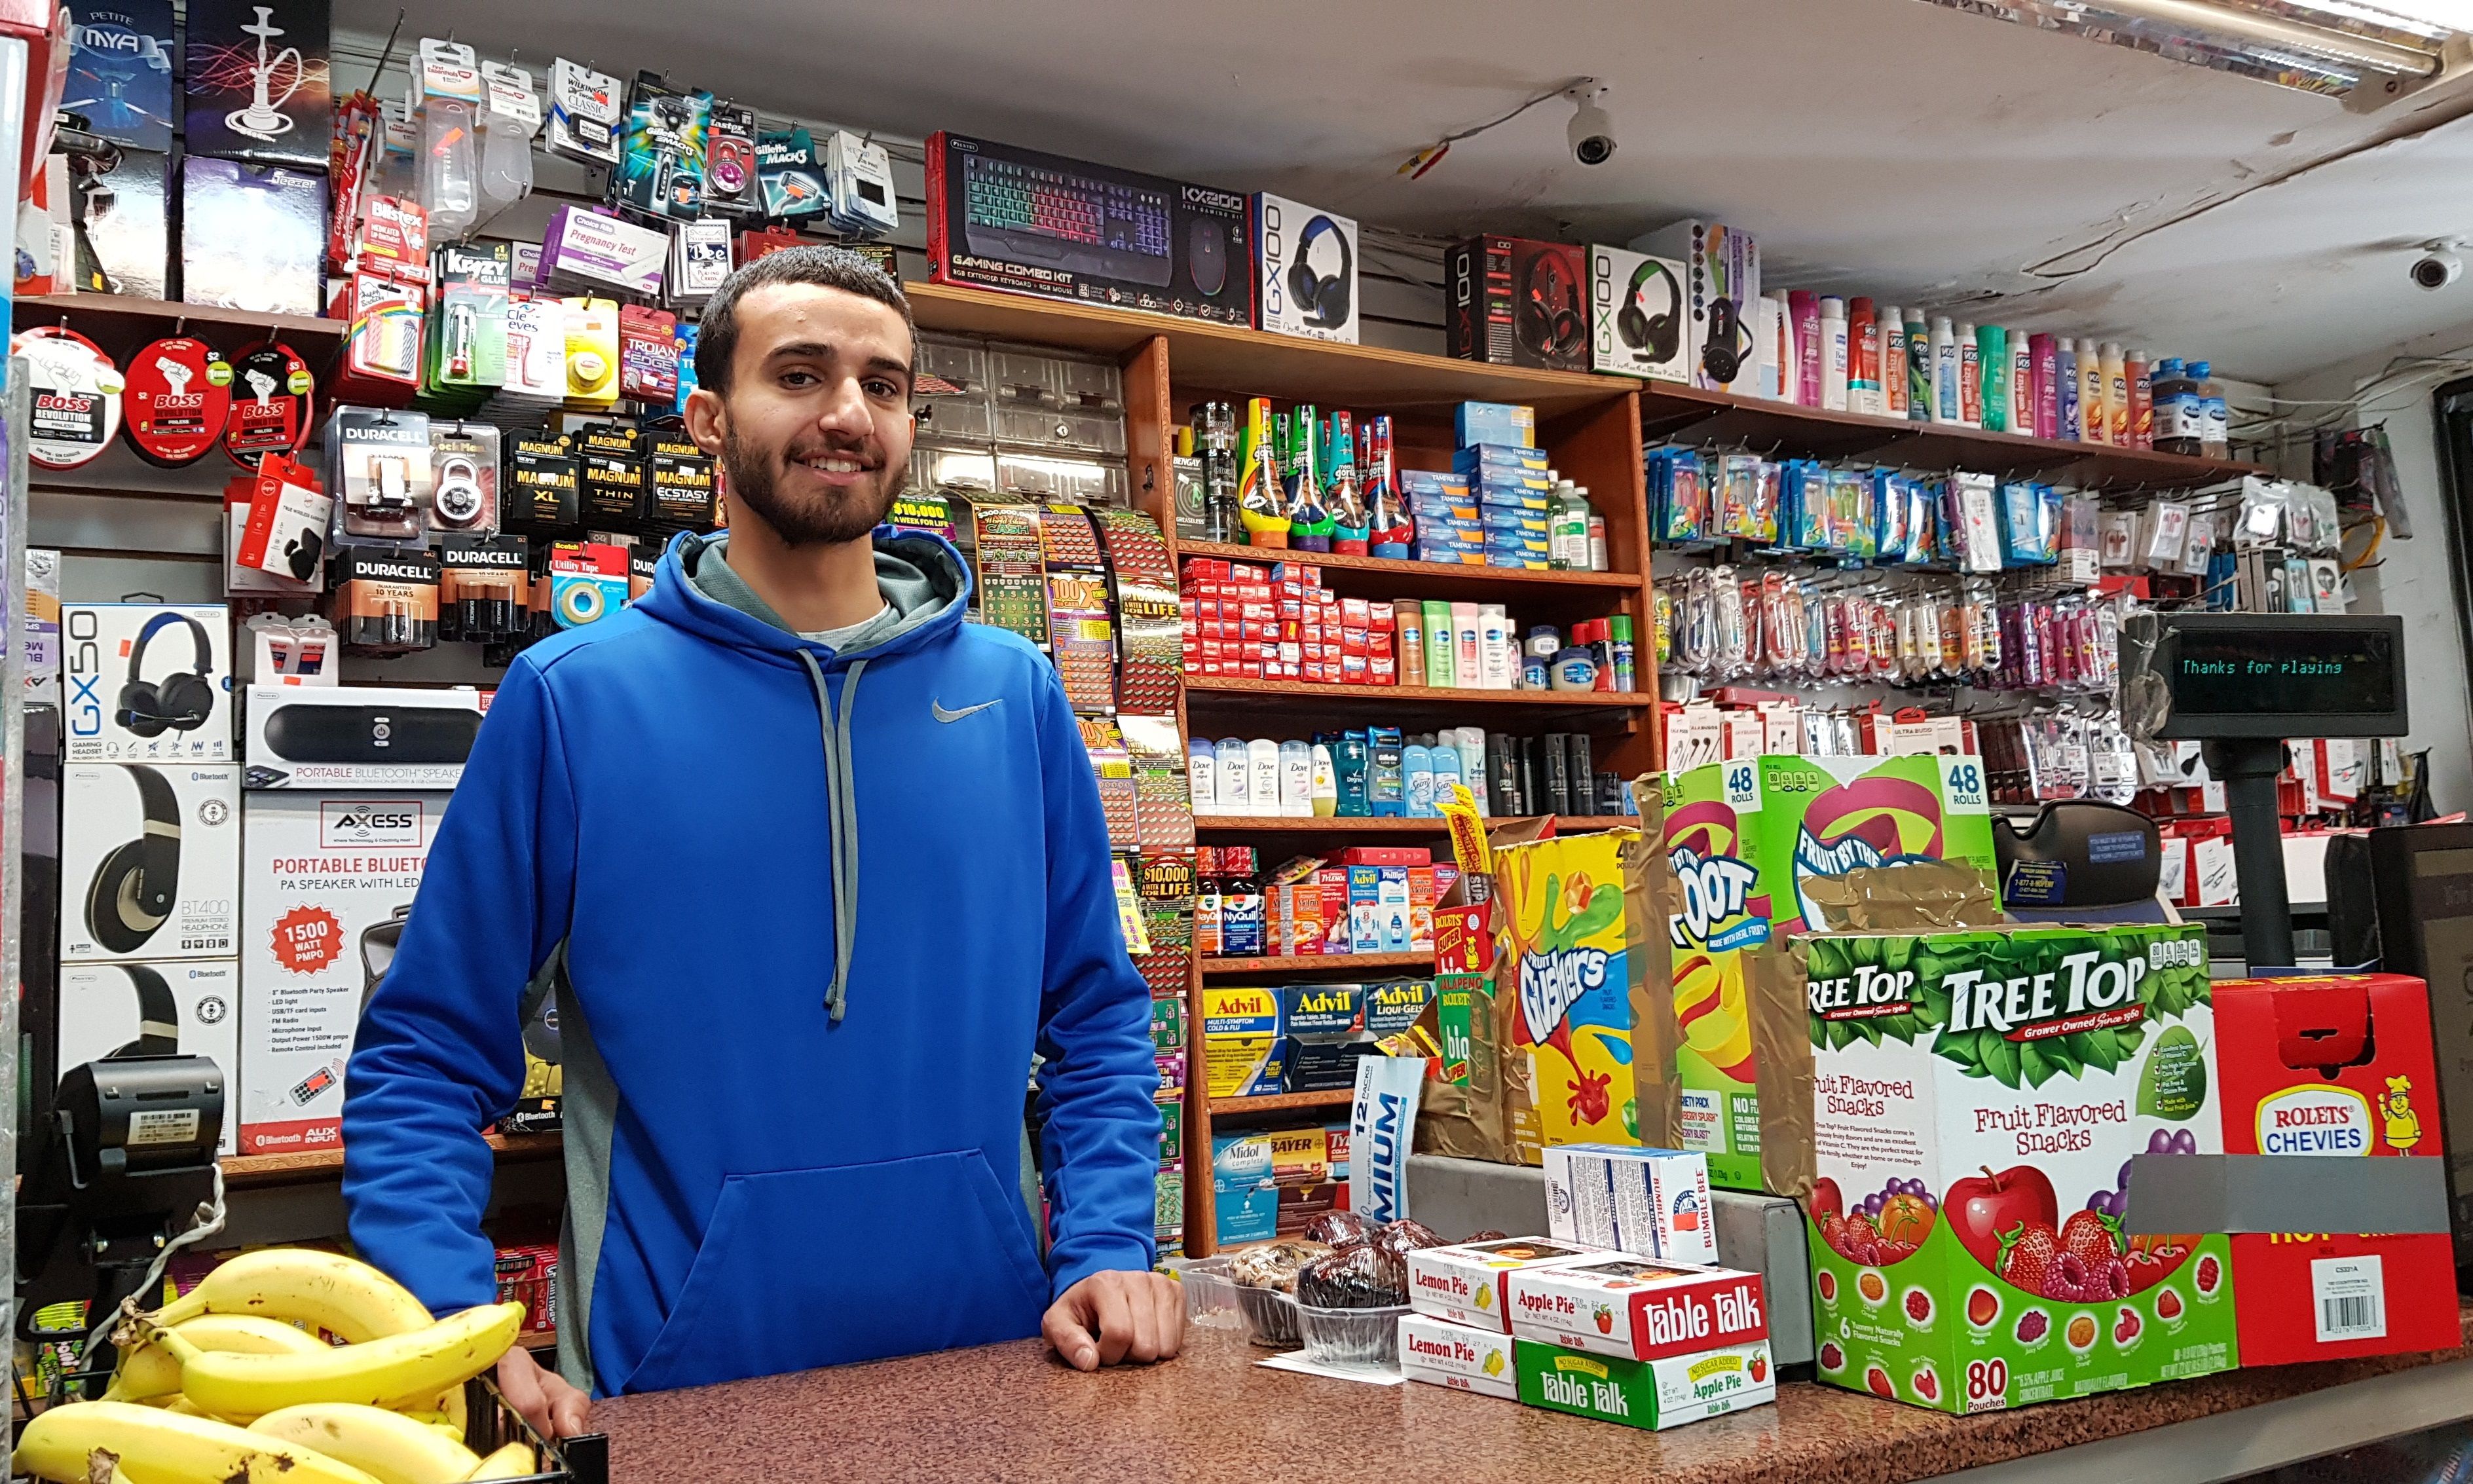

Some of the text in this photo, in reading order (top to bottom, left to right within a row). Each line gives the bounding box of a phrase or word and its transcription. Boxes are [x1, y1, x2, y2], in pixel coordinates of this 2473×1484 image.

[90, 11, 134, 25] PETITE
[568, 94, 605, 115] CLASSIC
[646, 126, 680, 141] Gillette
[755, 144, 787, 155] Gillette
[1181, 186, 1242, 210] KX200
[335, 191, 348, 236] Colgate
[371, 200, 422, 228] Blistex
[576, 217, 612, 233] Choice Rite
[570, 230, 637, 256] Pregnancy Test
[1265, 204, 1282, 316] GX100
[953, 254, 1073, 284] GAMING COMBO KIT
[481, 274, 508, 285] GLUE
[967, 270, 998, 282] EXTENDED
[1000, 276, 1032, 288] KEYBOARD
[1052, 286, 1073, 295] MOUSE
[1596, 255, 1612, 354] GX100
[37, 394, 92, 412] BOSS
[155, 393, 203, 408] BOSS
[35, 409, 92, 422] REVOLUTION
[242, 403, 286, 419] BOSS
[345, 427, 424, 443] DURACELL
[588, 435, 631, 449] MAGNUM
[519, 441, 563, 456] MAGNUM
[657, 443, 699, 456] MAGNUM
[1173, 457, 1200, 468] BENGAY
[533, 489, 560, 503] XL
[593, 489, 633, 500] THIN
[657, 487, 709, 500] ECSTASY
[1246, 498, 1263, 506] punk
[893, 502, 944, 519] $10,000
[986, 523, 1030, 534] CASH
[447, 550, 523, 565] DURACELL
[356, 562, 432, 580] DURACELL
[582, 561, 599, 574] Tape
[375, 588, 385, 597] 10
[1051, 579, 1080, 600] 100
[1144, 602, 1177, 616] LIFE
[69, 610, 101, 736] GX50
[2183, 659, 2235, 675] Thanks
[2246, 659, 2273, 675] for
[296, 768, 352, 778] PORTABLE
[1193, 761, 1210, 770] Dove
[1227, 762, 1245, 770] Dove
[1258, 762, 1274, 770] Dove
[1291, 764, 1309, 772] Dove
[1728, 766, 1753, 793] 48
[1948, 764, 1980, 794] 48
[1732, 792, 1753, 804] ROLLS
[1954, 794, 1981, 806] ROLLS
[1800, 828, 1880, 874] FRUIT BY THE
[273, 858, 362, 874] PORTABLE
[1144, 866, 1189, 881] $10,000
[281, 878, 419, 890] PA SPEAKER WITH LED
[1352, 873, 1377, 885] Advil
[1159, 883, 1192, 896] LIFE
[181, 900, 230, 915] BT400
[1223, 910, 1256, 921] NyQuil
[1435, 914, 1462, 929] ROLETS
[284, 920, 328, 943] 1500
[1709, 929, 1748, 948] MADE WITH REAL
[295, 939, 322, 953] WATT
[1440, 929, 1460, 952] SUPER
[296, 950, 324, 963] PMPO
[1528, 944, 1550, 969] FRUIT
[1853, 965, 1914, 1005] TOP
[1941, 951, 2146, 1034] TREE TOP
[1296, 991, 1352, 1012] Advil
[1375, 984, 1424, 1005] Advil
[1216, 996, 1261, 1015] Advil
[1831, 1007, 1875, 1019] Grower Owned
[2024, 1009, 2140, 1039] Grower Owned Since 1960
[1362, 1065, 1370, 1100] PACKS
[1839, 1075, 1914, 1100] Flavored
[1697, 1096, 1709, 1108] PACK
[1733, 1097, 1748, 1113] NO
[1827, 1095, 1885, 1117] Snacks
[1355, 1101, 1368, 1137] 12
[1974, 1100, 2127, 1133] Fruit Flavored
[2275, 1106, 2350, 1128] ROLETS
[306, 1127, 337, 1137] AUX
[1396, 1104, 1405, 1151] CRACKERS
[305, 1134, 337, 1143] INPUT
[2017, 1128, 2092, 1156] Snacks
[2266, 1128, 2361, 1153] CHEVIES
[1229, 1145, 1259, 1160] Midol
[1653, 1178, 1665, 1227] BUMBLE
[1696, 1168, 1712, 1248] BUMBLE BEE
[1415, 1268, 1468, 1296] Lemon Pie
[1518, 1289, 1574, 1314] Apple Pie
[1643, 1285, 1761, 1346] Table Talk
[1840, 1316, 1904, 1340] 6 Yummy Naturally
[1853, 1330, 1901, 1346] Flavored Snacks
[1409, 1333, 1474, 1362] Lemon Pie
[1558, 1357, 1605, 1373] NO SUGAR ADDED
[1700, 1358, 1738, 1373] SUGAR ADDED
[1446, 1376, 1470, 1389] Table Talk
[1692, 1374, 1741, 1400] Apple Pie
[1968, 1359, 2006, 1400] 80
[1540, 1371, 1629, 1417] Table Talk
[1968, 1398, 2005, 1412] Pouches
